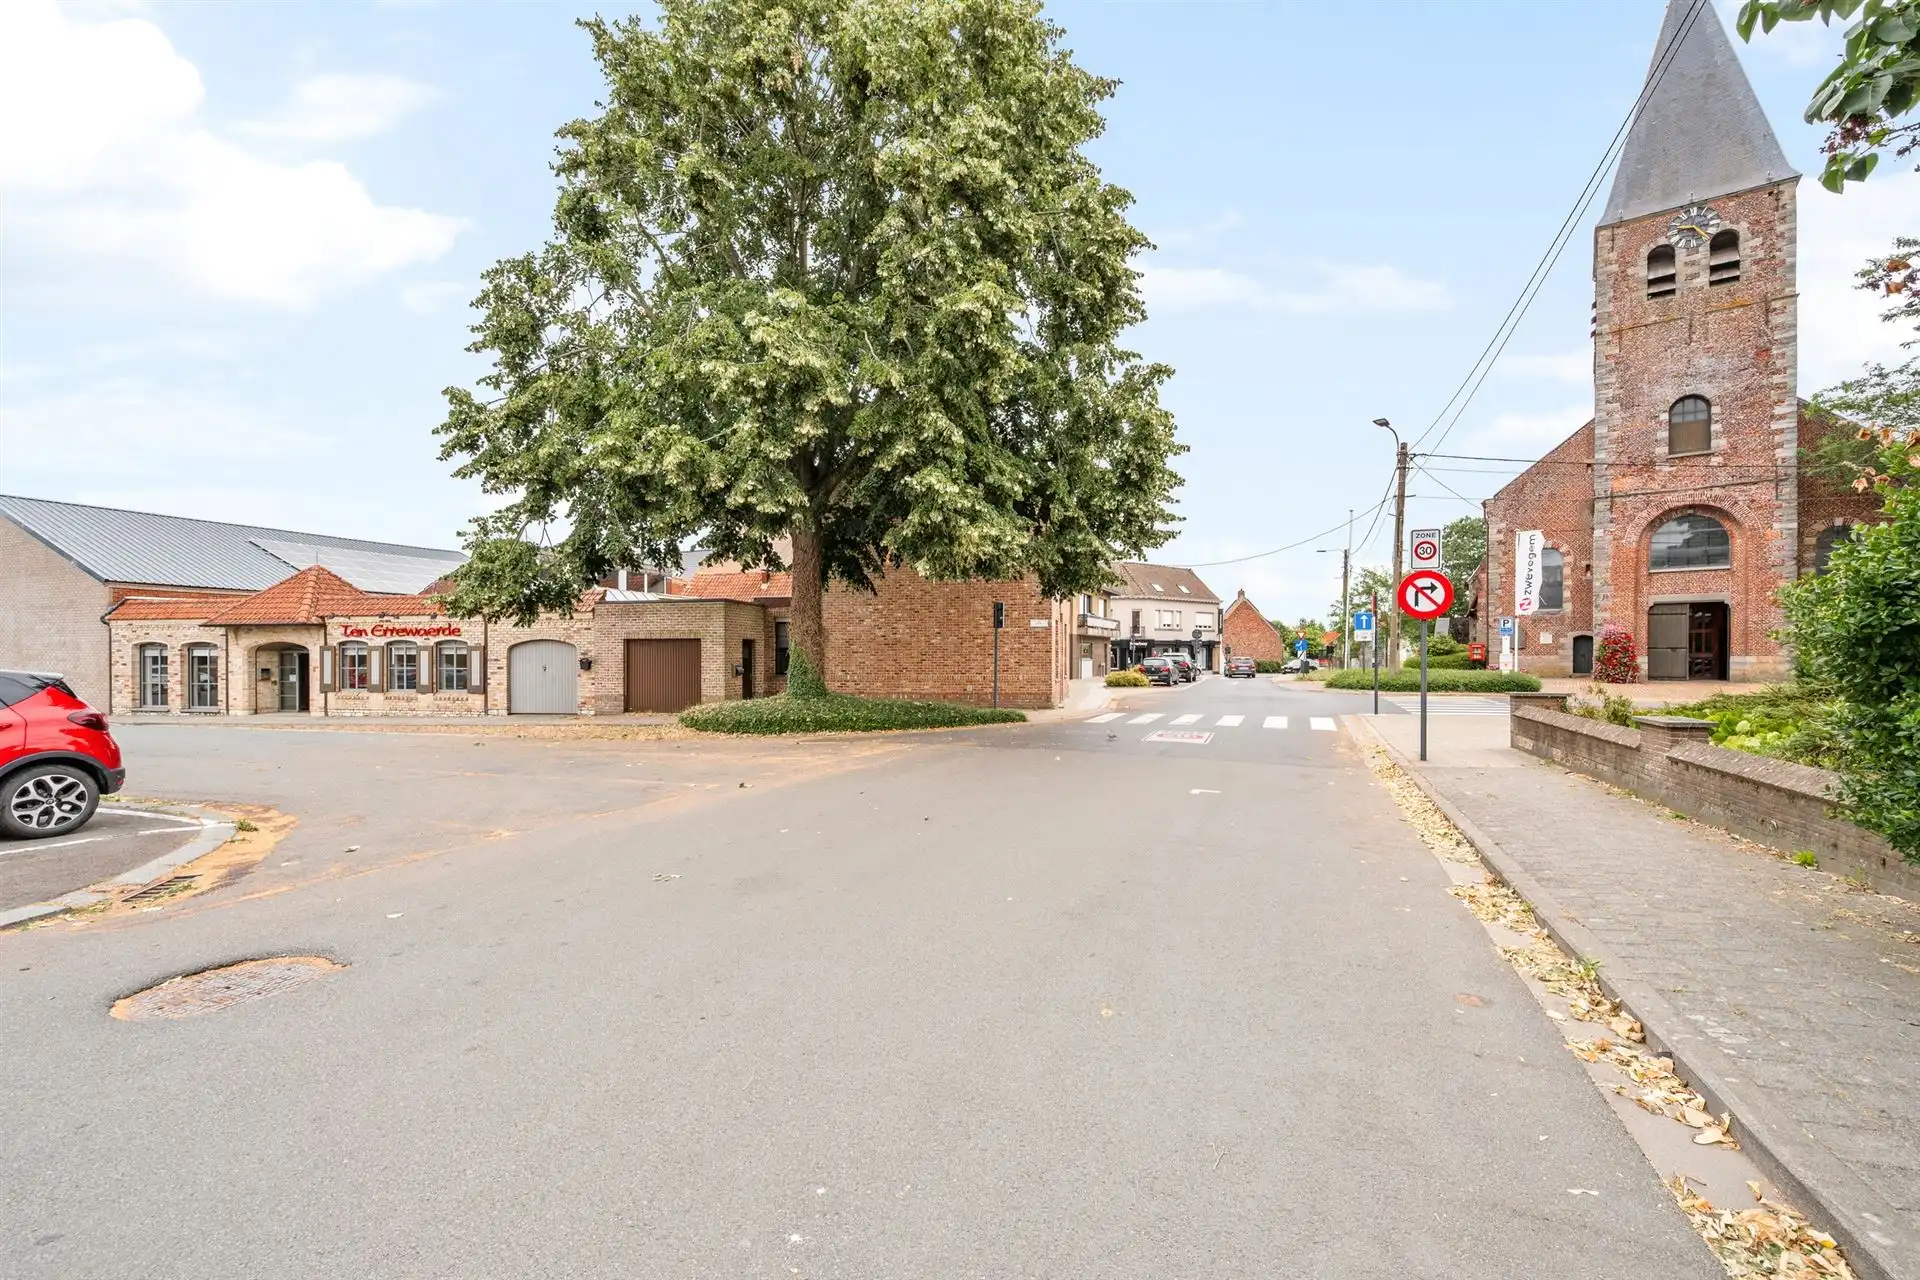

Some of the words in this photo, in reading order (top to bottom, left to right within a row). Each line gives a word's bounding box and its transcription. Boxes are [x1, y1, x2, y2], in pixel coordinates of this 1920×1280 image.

[1419, 546, 1432, 556] 30
[1524, 533, 1537, 596] zwevegem
[1502, 619, 1510, 627] P
[340, 623, 369, 638] Ten
[370, 622, 462, 638] Errewaerde
